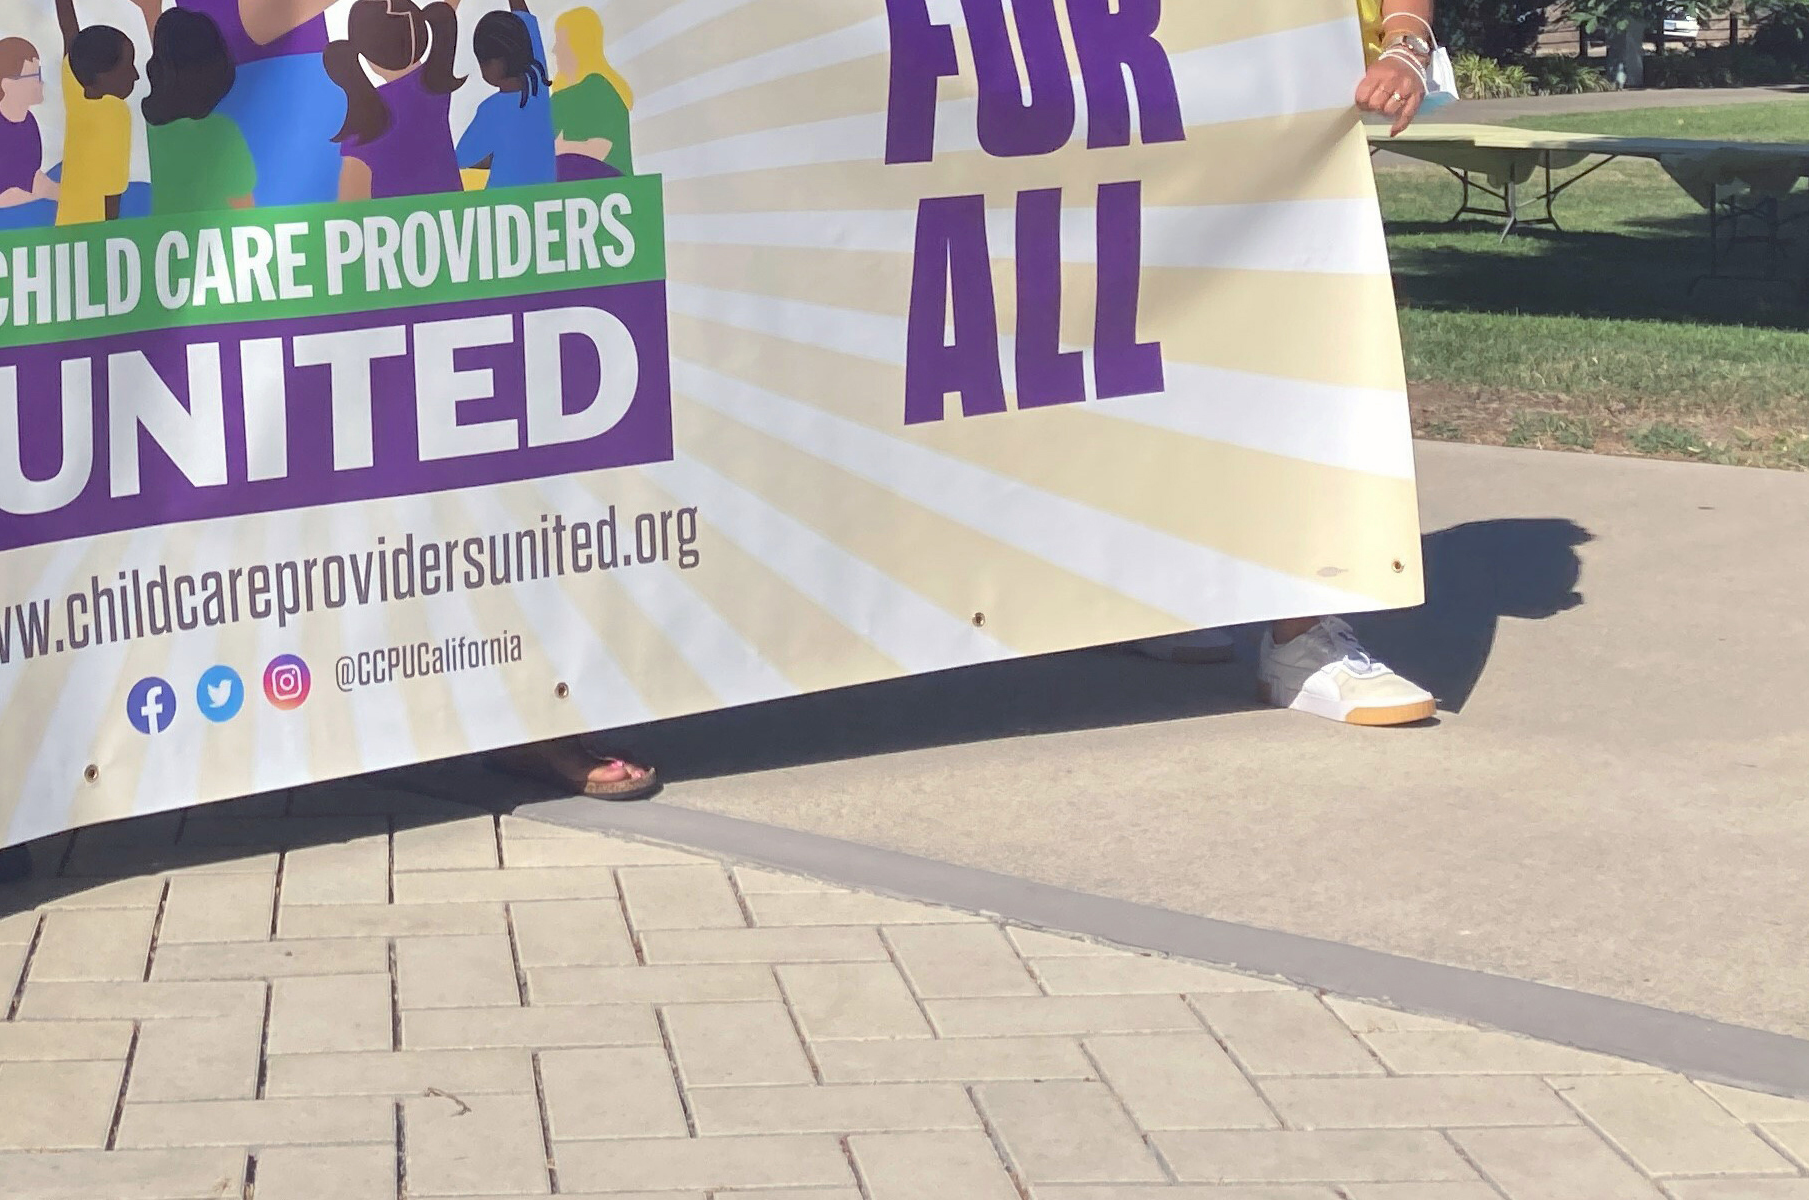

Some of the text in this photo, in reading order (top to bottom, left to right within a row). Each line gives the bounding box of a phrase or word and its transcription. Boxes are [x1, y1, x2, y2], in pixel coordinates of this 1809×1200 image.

[155, 221, 314, 307] CARE
[325, 192, 636, 296] PROVIDERS
[904, 180, 1165, 425] ALL
[336, 630, 523, 692] @CCPUCalifornia
